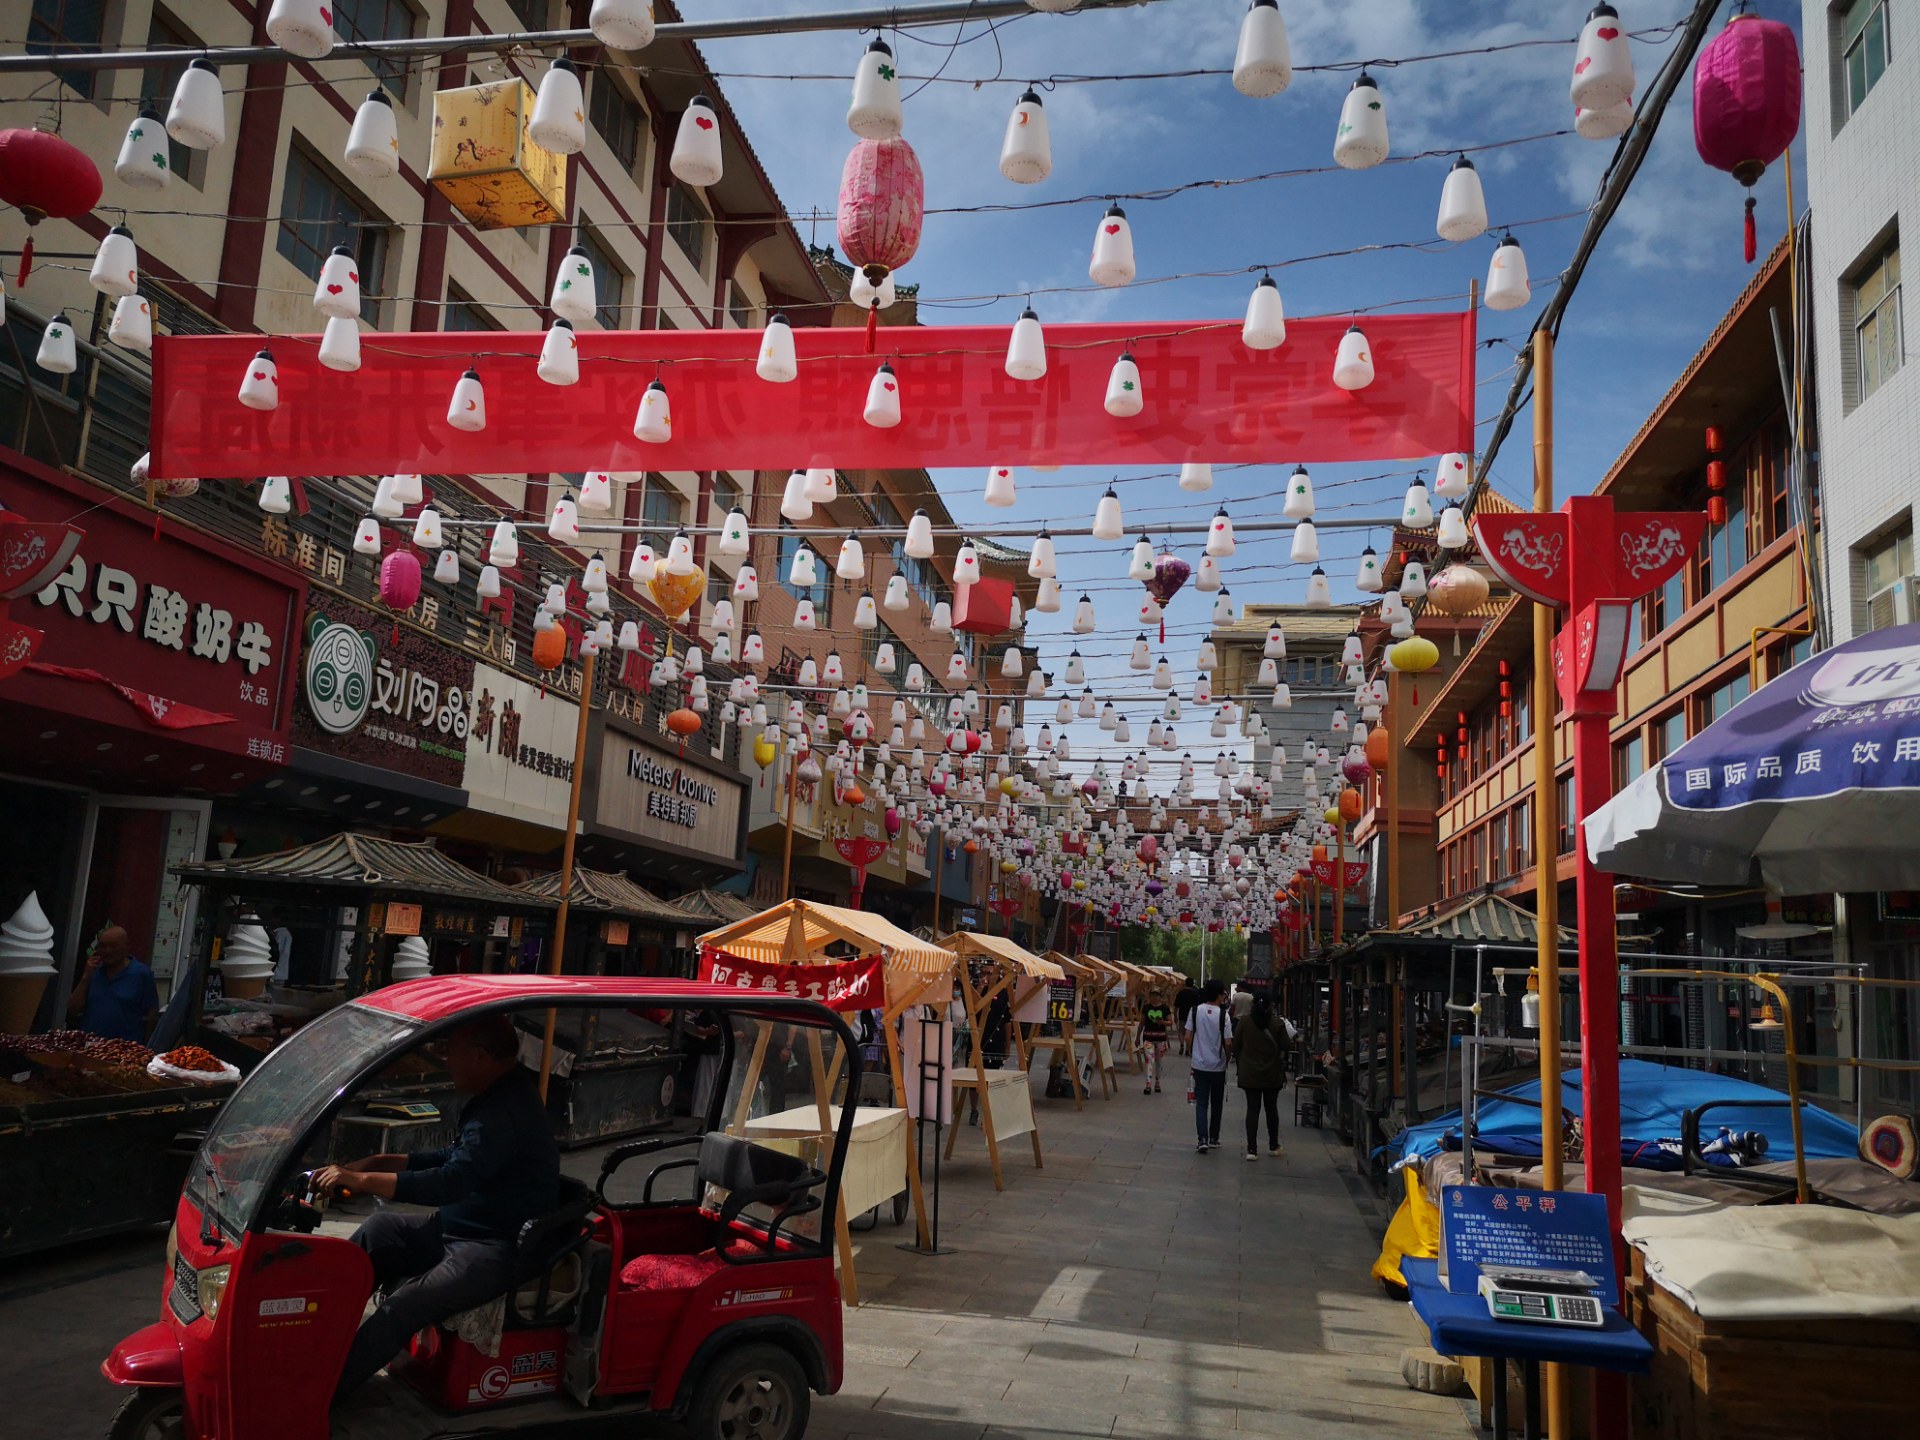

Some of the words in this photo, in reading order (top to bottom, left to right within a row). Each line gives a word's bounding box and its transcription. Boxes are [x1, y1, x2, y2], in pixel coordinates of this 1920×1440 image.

[262, 516, 346, 586] 标准间
[463, 617, 517, 666] 三人间
[240, 680, 269, 706] 饮品
[606, 690, 643, 726] 八人间
[247, 738, 284, 763] 连锁店
[1685, 749, 1822, 793] 国际品质
[647, 792, 698, 827] 美特斯邦威
[1492, 1194, 1556, 1213] 公平秤
